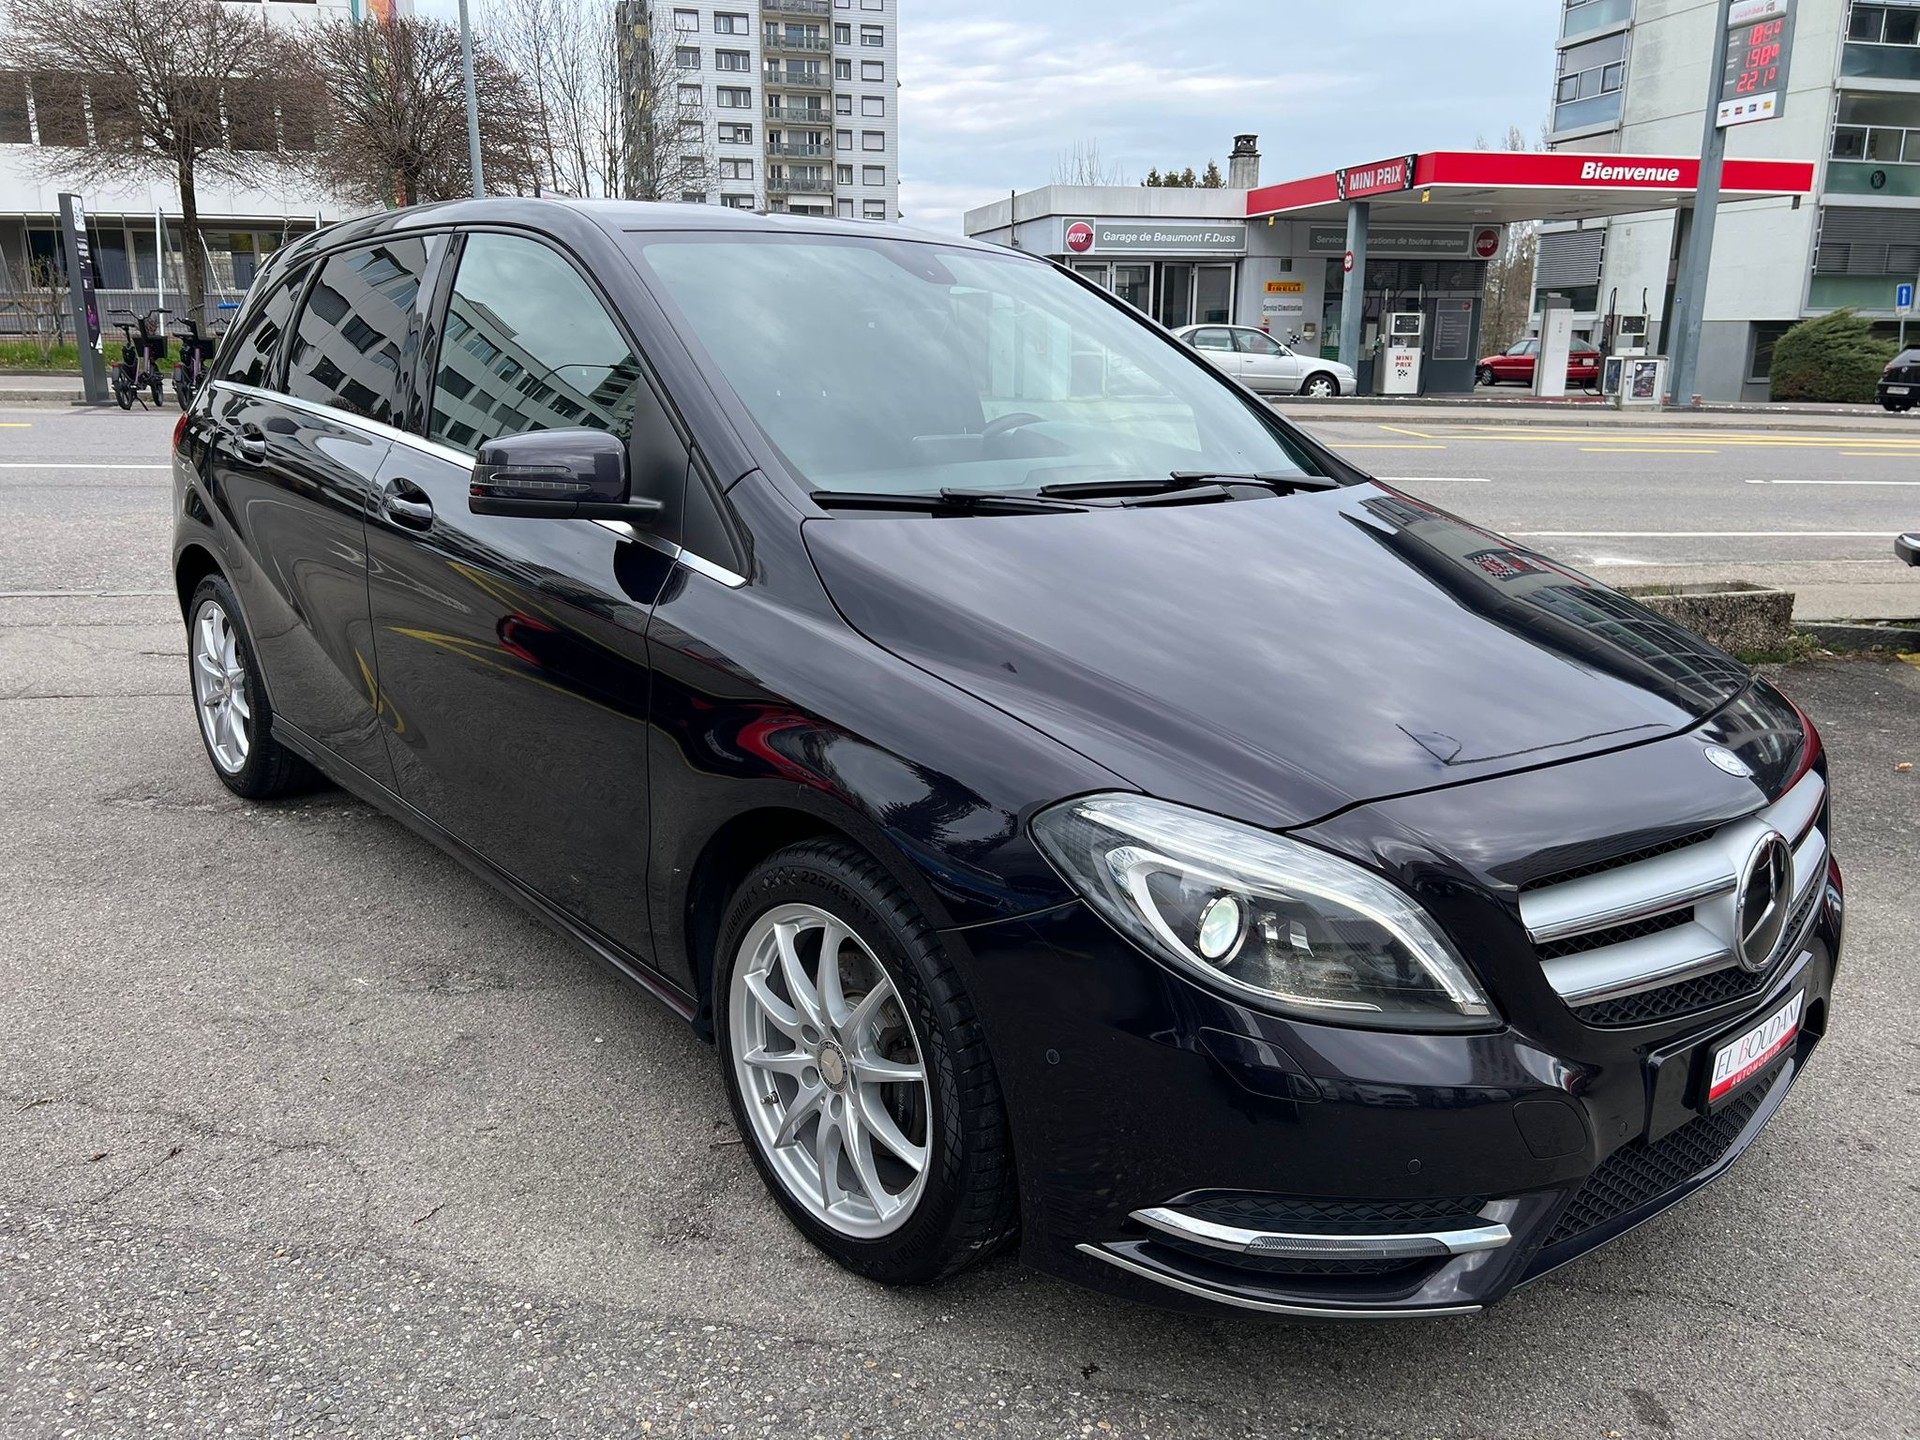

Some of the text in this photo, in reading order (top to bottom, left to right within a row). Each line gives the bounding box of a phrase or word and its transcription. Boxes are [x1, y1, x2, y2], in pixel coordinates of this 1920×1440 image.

[1349, 164, 1402, 191] MINI PRIX
[1580, 161, 1680, 182] Bienvenue
[1102, 231, 1236, 243] Garage de Beaumont F.Duss
[1315, 235, 1344, 244] Service
[1397, 238, 1407, 246] de
[1408, 238, 1431, 246] toutes
[1433, 239, 1465, 248] marques
[1267, 282, 1301, 292] PIRELLI
[801, 870, 879, 925] 225/45 R 17
[1715, 1048, 1732, 1082] EL
[1730, 1042, 1780, 1088] AUTOMOBILES
